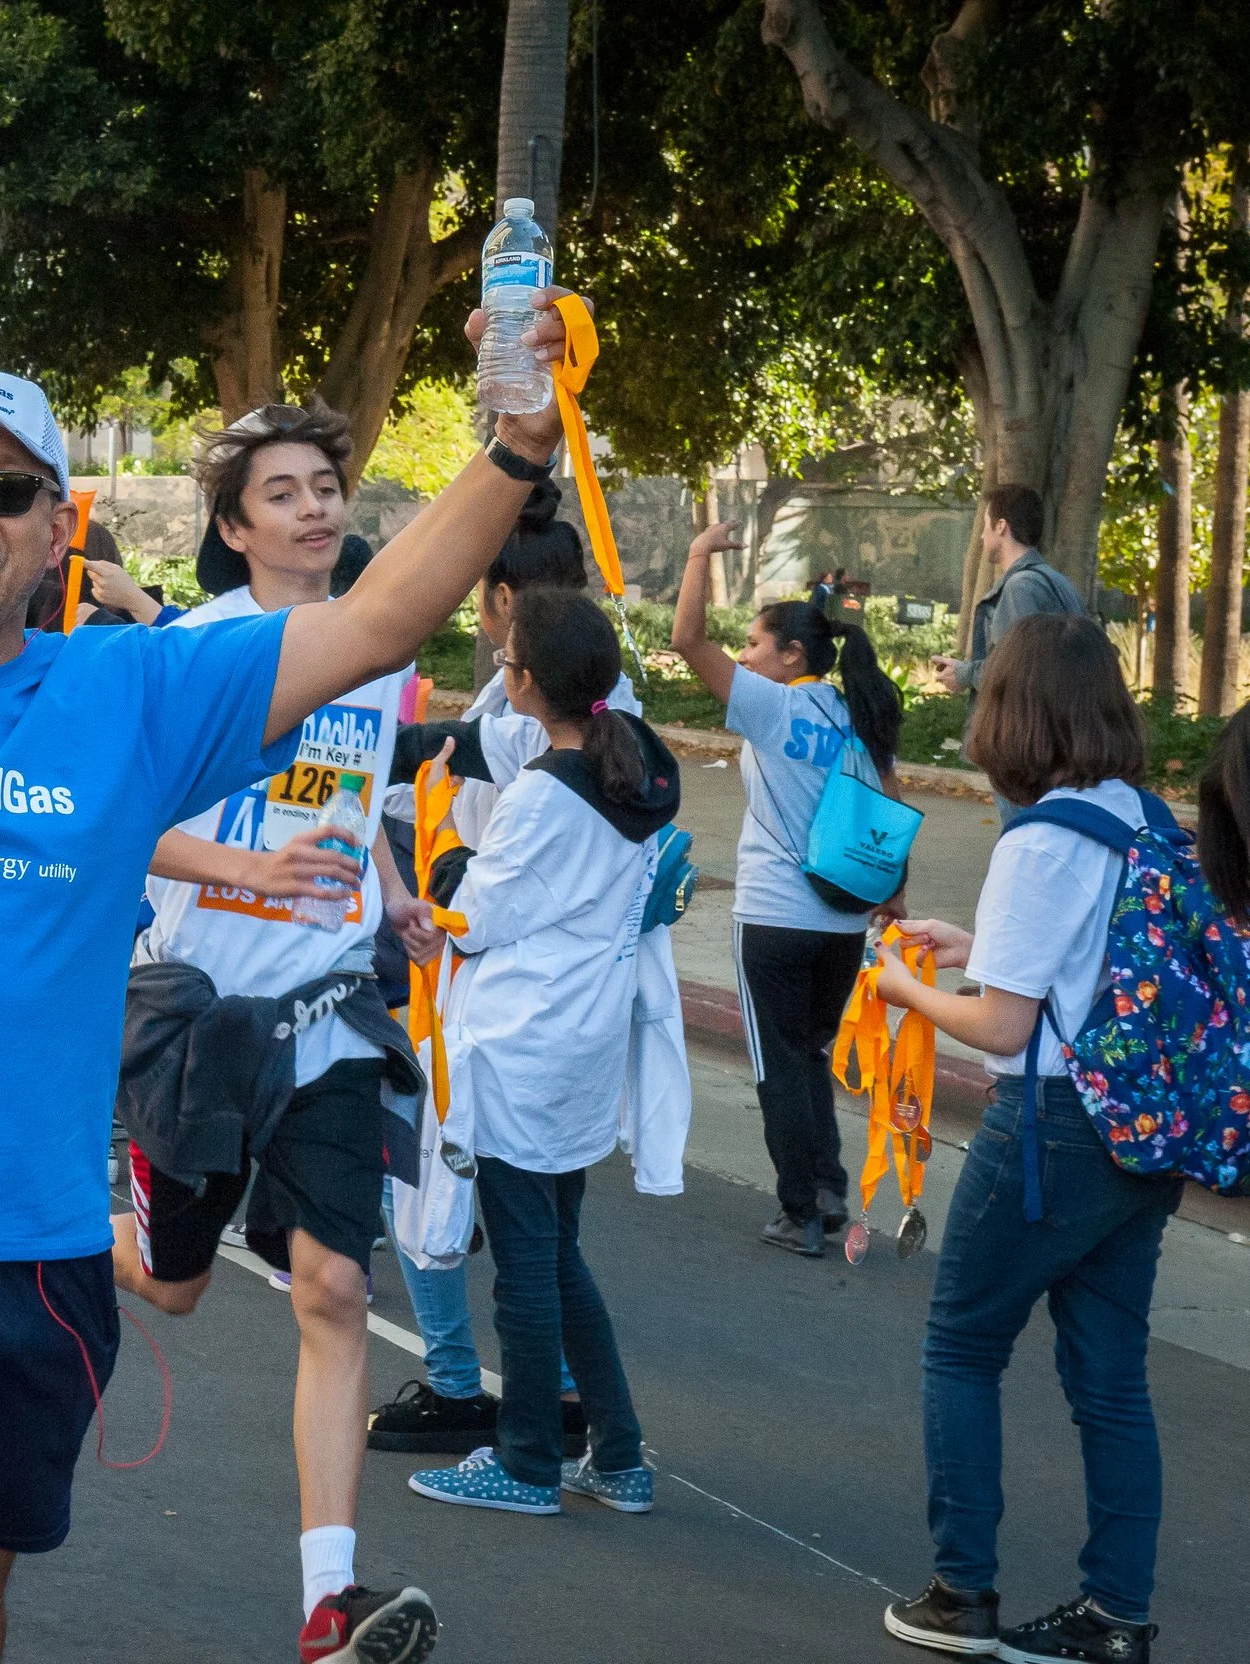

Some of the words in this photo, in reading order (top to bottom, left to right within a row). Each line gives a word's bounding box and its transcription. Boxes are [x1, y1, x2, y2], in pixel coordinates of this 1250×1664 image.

[299, 743, 321, 760] I'm
[326, 746, 350, 767] Key
[353, 752, 362, 765] #
[279, 764, 336, 807] 126
[38, 863, 77, 883] utility
